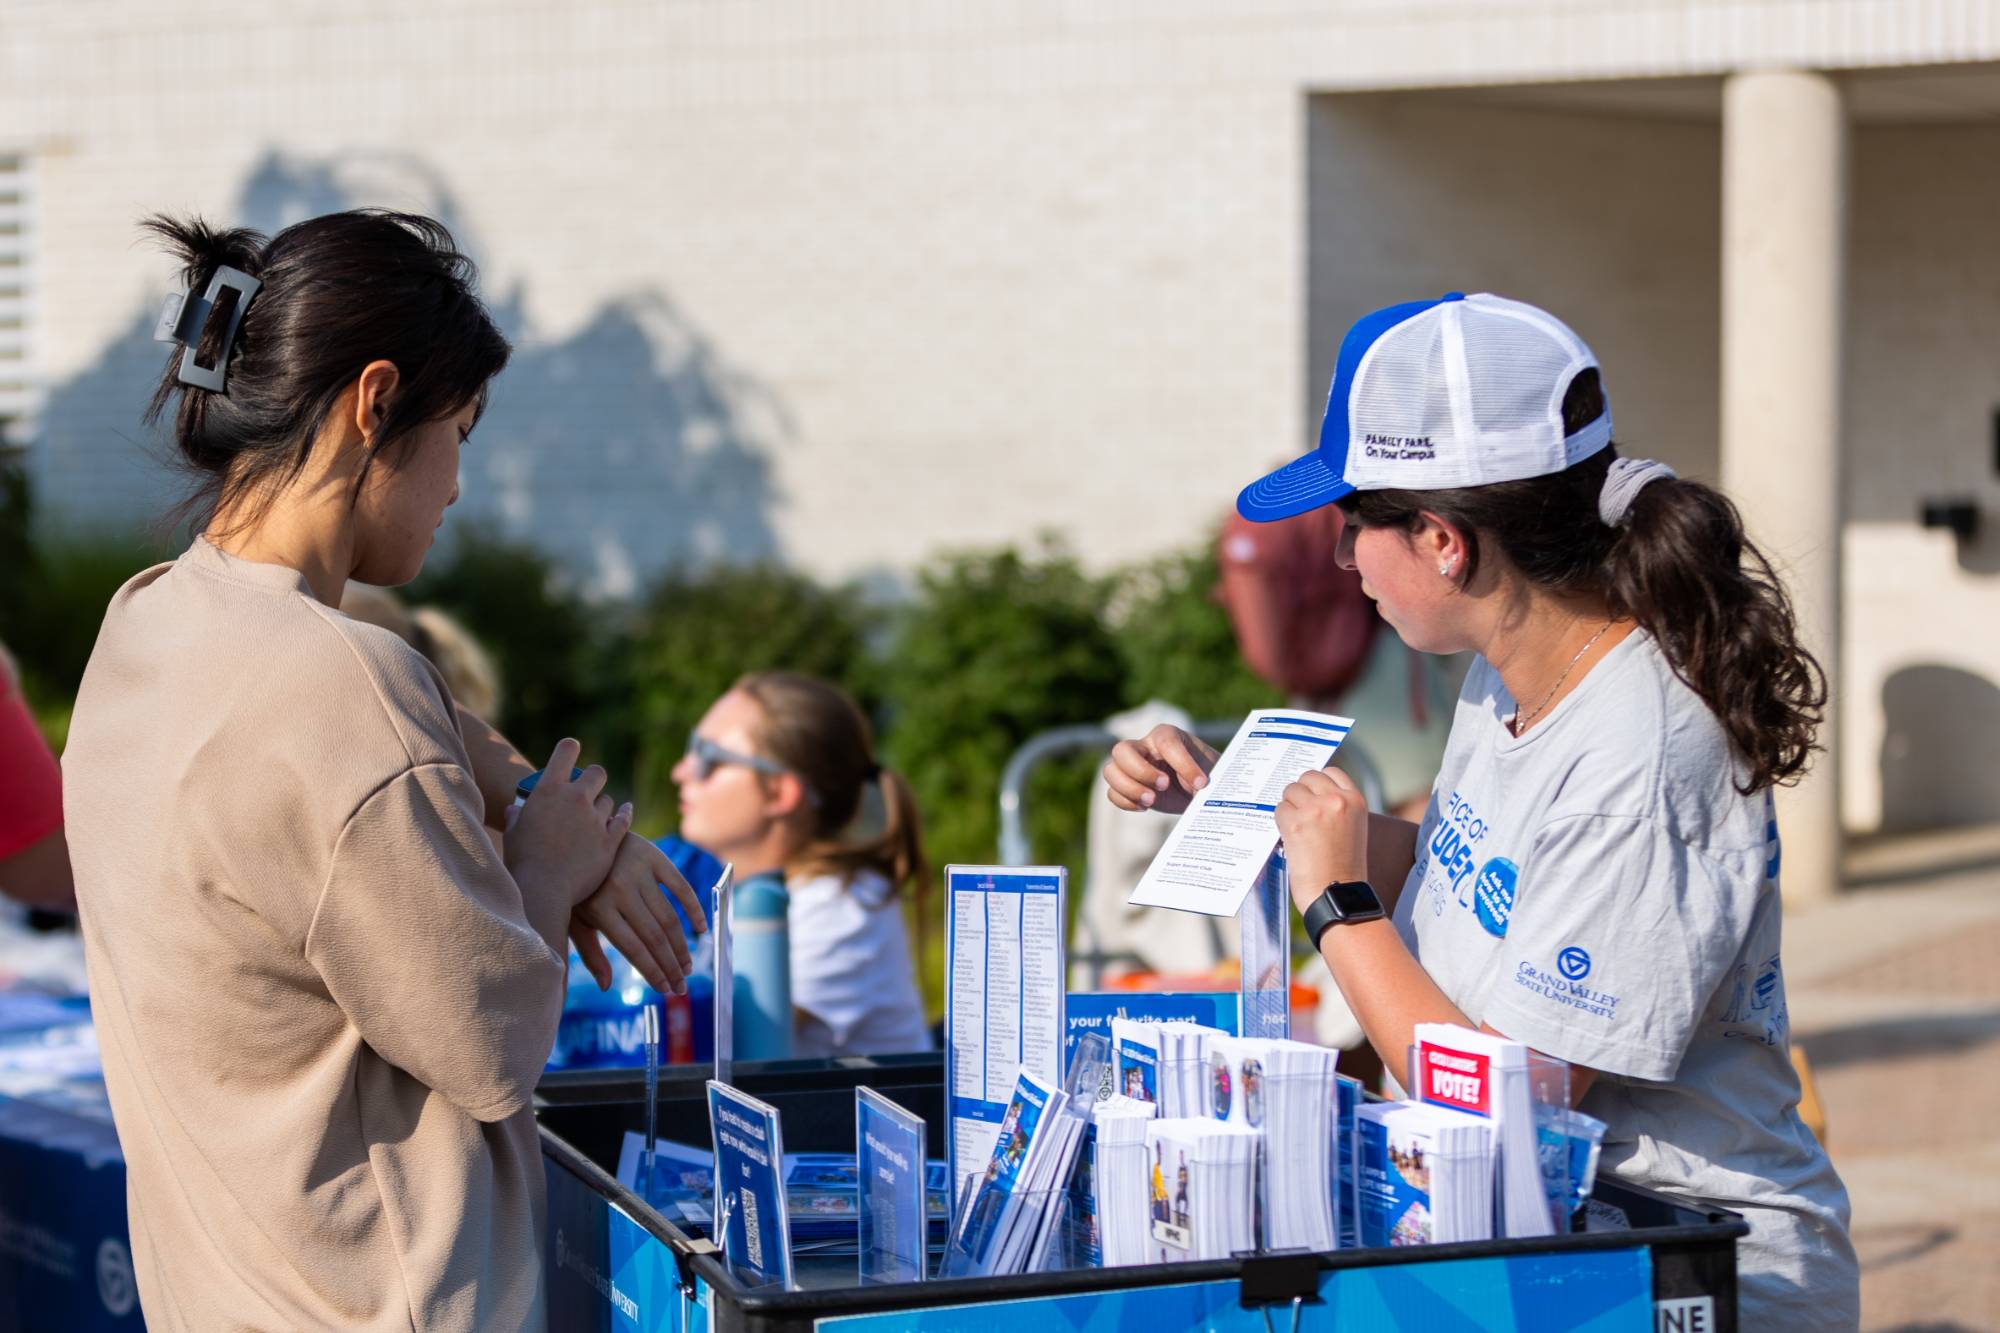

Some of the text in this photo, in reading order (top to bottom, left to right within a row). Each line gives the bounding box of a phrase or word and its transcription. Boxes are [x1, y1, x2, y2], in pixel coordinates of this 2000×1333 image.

[1365, 434, 1402, 447] FAMILY
[1366, 446, 1435, 461] On Your Campus
[1489, 871, 1512, 904] Ask me
[1514, 972, 1542, 994] STATE
[1519, 961, 1622, 1008] GRAND VALLEY
[1069, 1016, 1103, 1030] your
[1432, 1068, 1482, 1105] VOTE!
